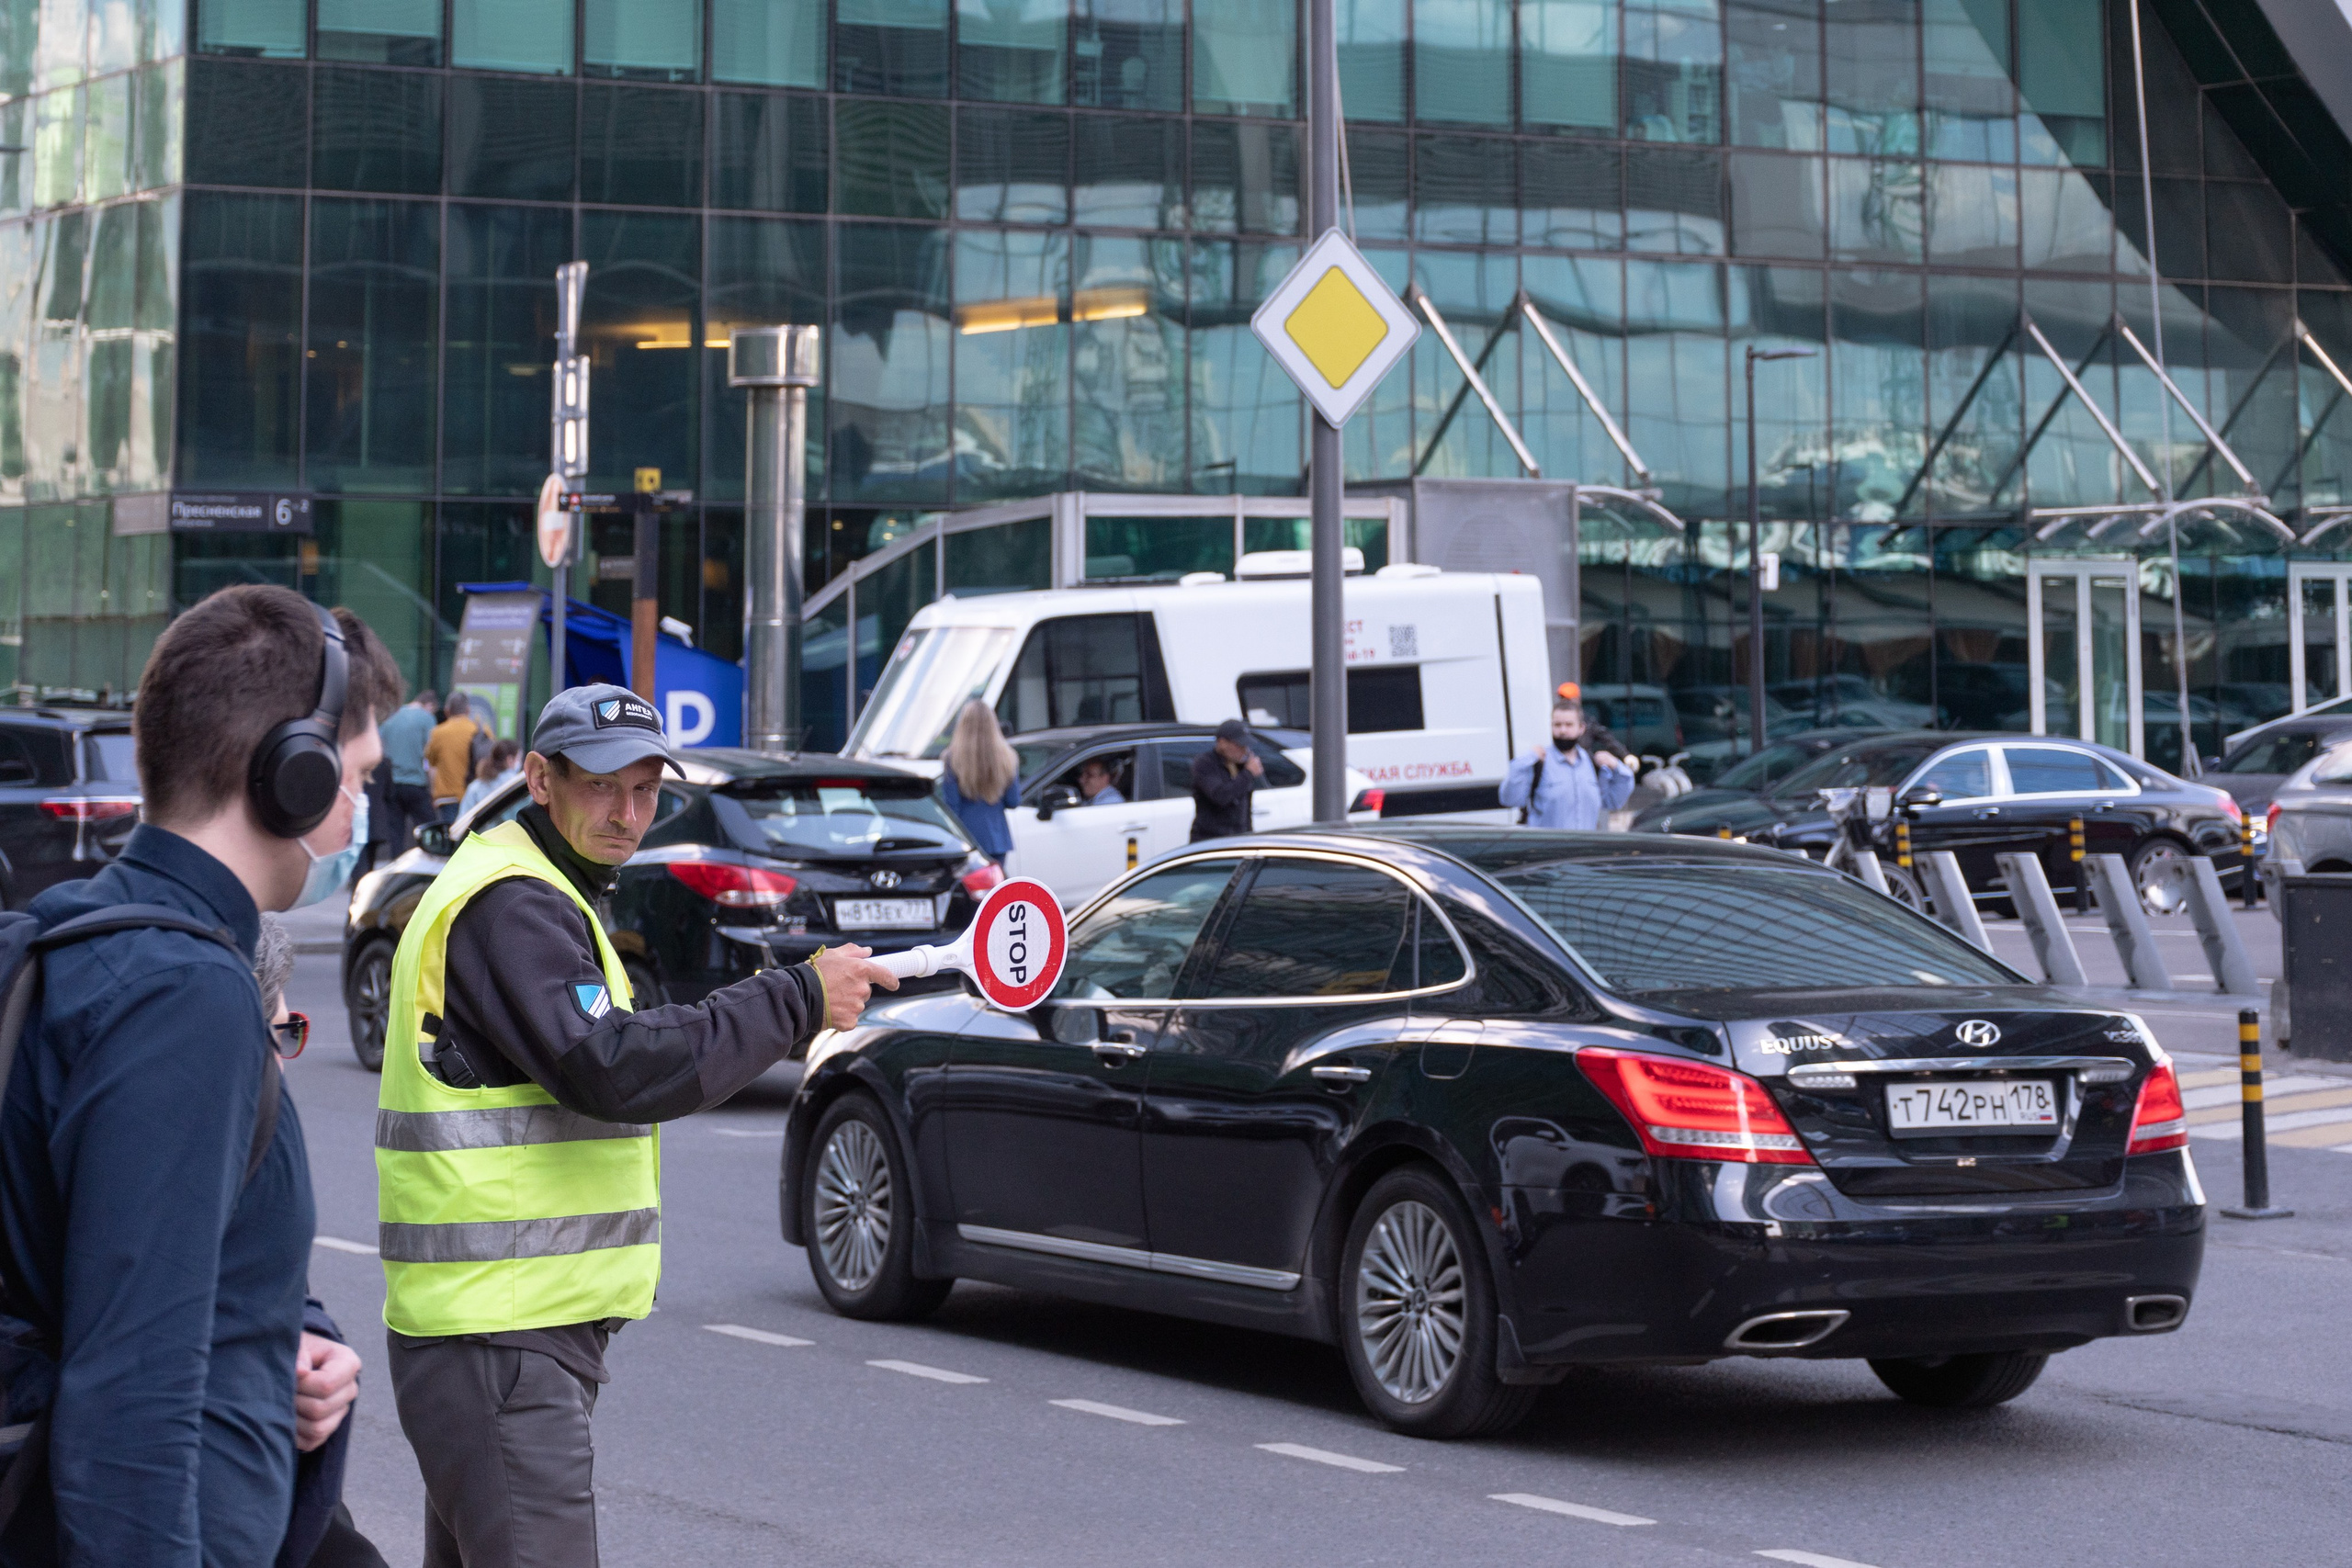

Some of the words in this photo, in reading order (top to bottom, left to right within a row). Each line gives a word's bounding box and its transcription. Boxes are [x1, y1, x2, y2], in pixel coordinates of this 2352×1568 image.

[276, 498, 292, 525] 6
[625, 703, 653, 717] АНГЕЛ
[666, 690, 717, 750] P
[1403, 761, 1474, 781] СЛУЖБА
[1009, 904, 1027, 984] STOP
[1759, 1034, 1834, 1055] EQUUS
